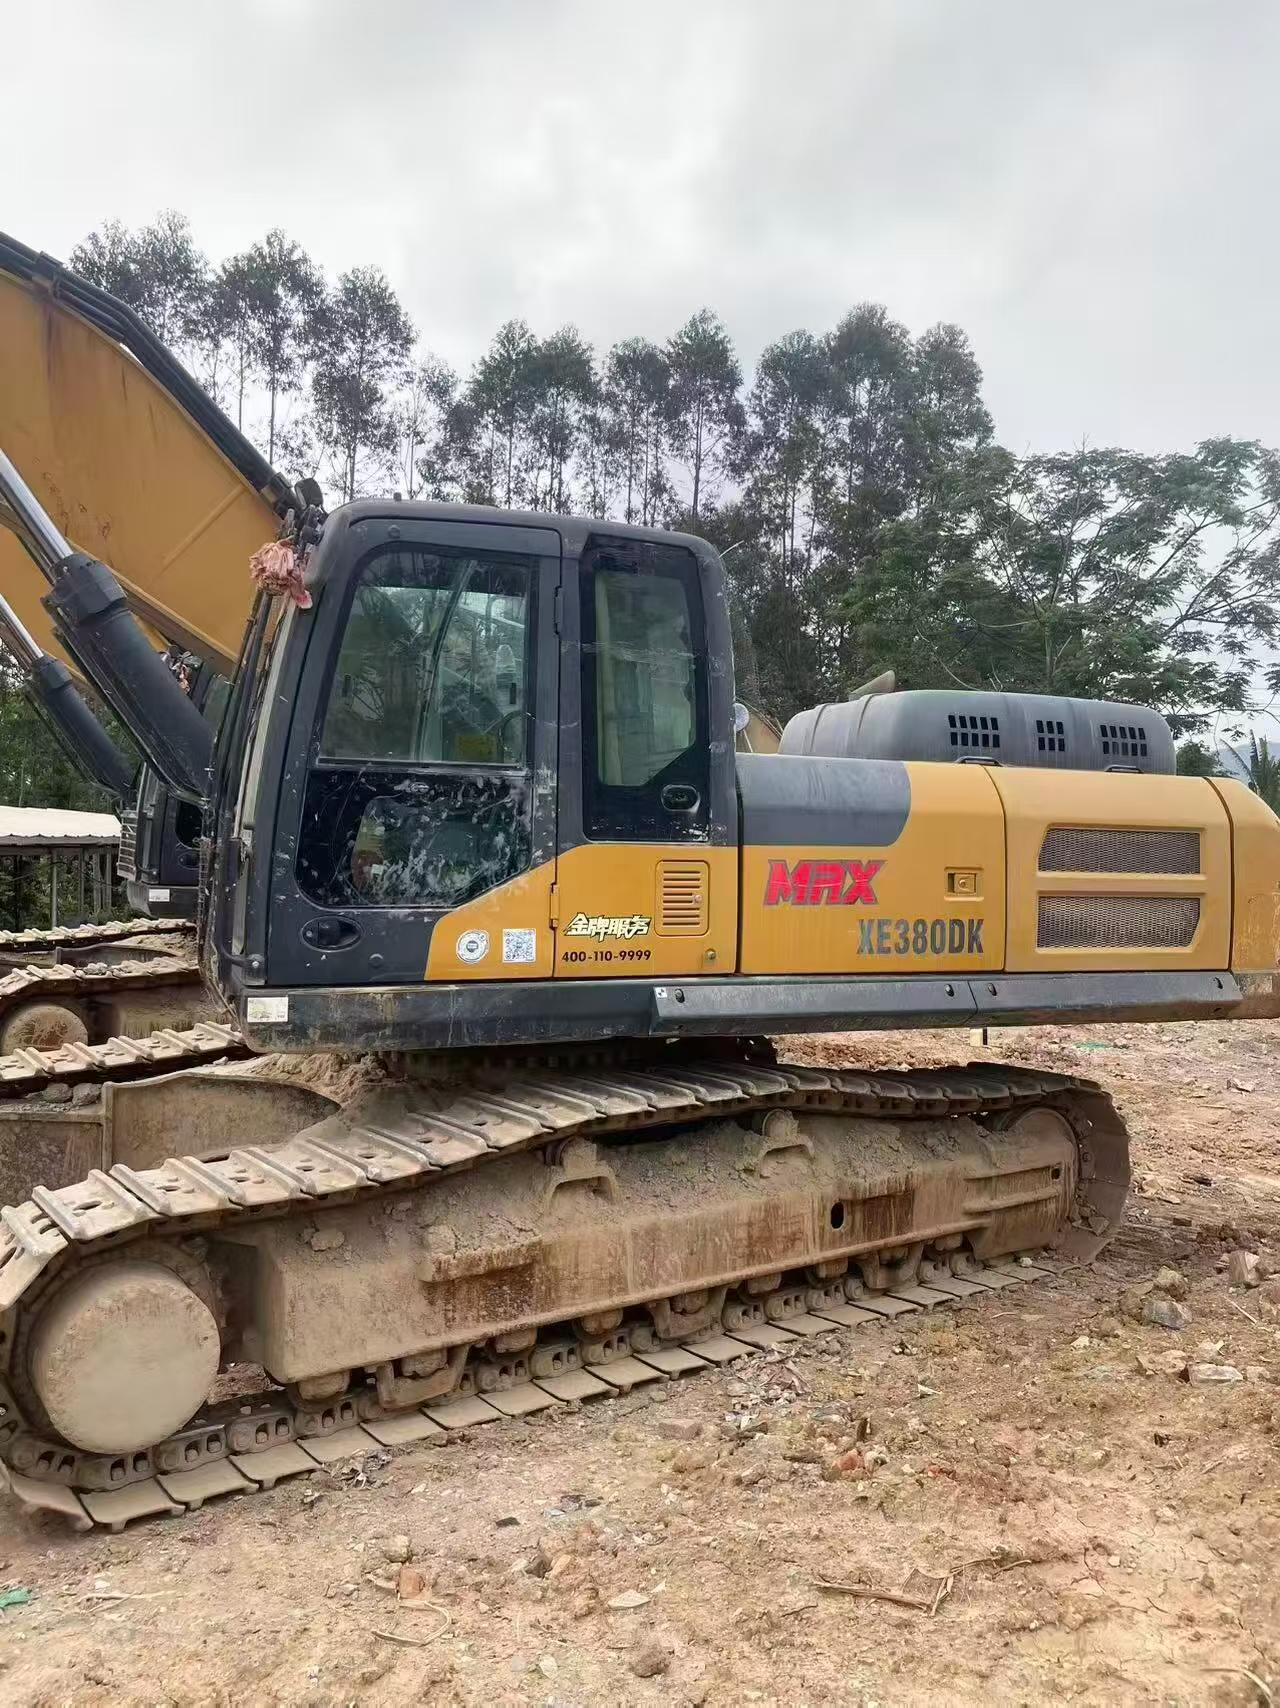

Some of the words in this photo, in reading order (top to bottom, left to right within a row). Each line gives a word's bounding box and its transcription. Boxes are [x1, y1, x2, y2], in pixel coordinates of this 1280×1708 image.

[763, 859, 887, 906] MAX
[564, 912, 652, 942] 金牌服务
[856, 918, 984, 955] XE380DK
[561, 949, 652, 962] 400-110-9999
